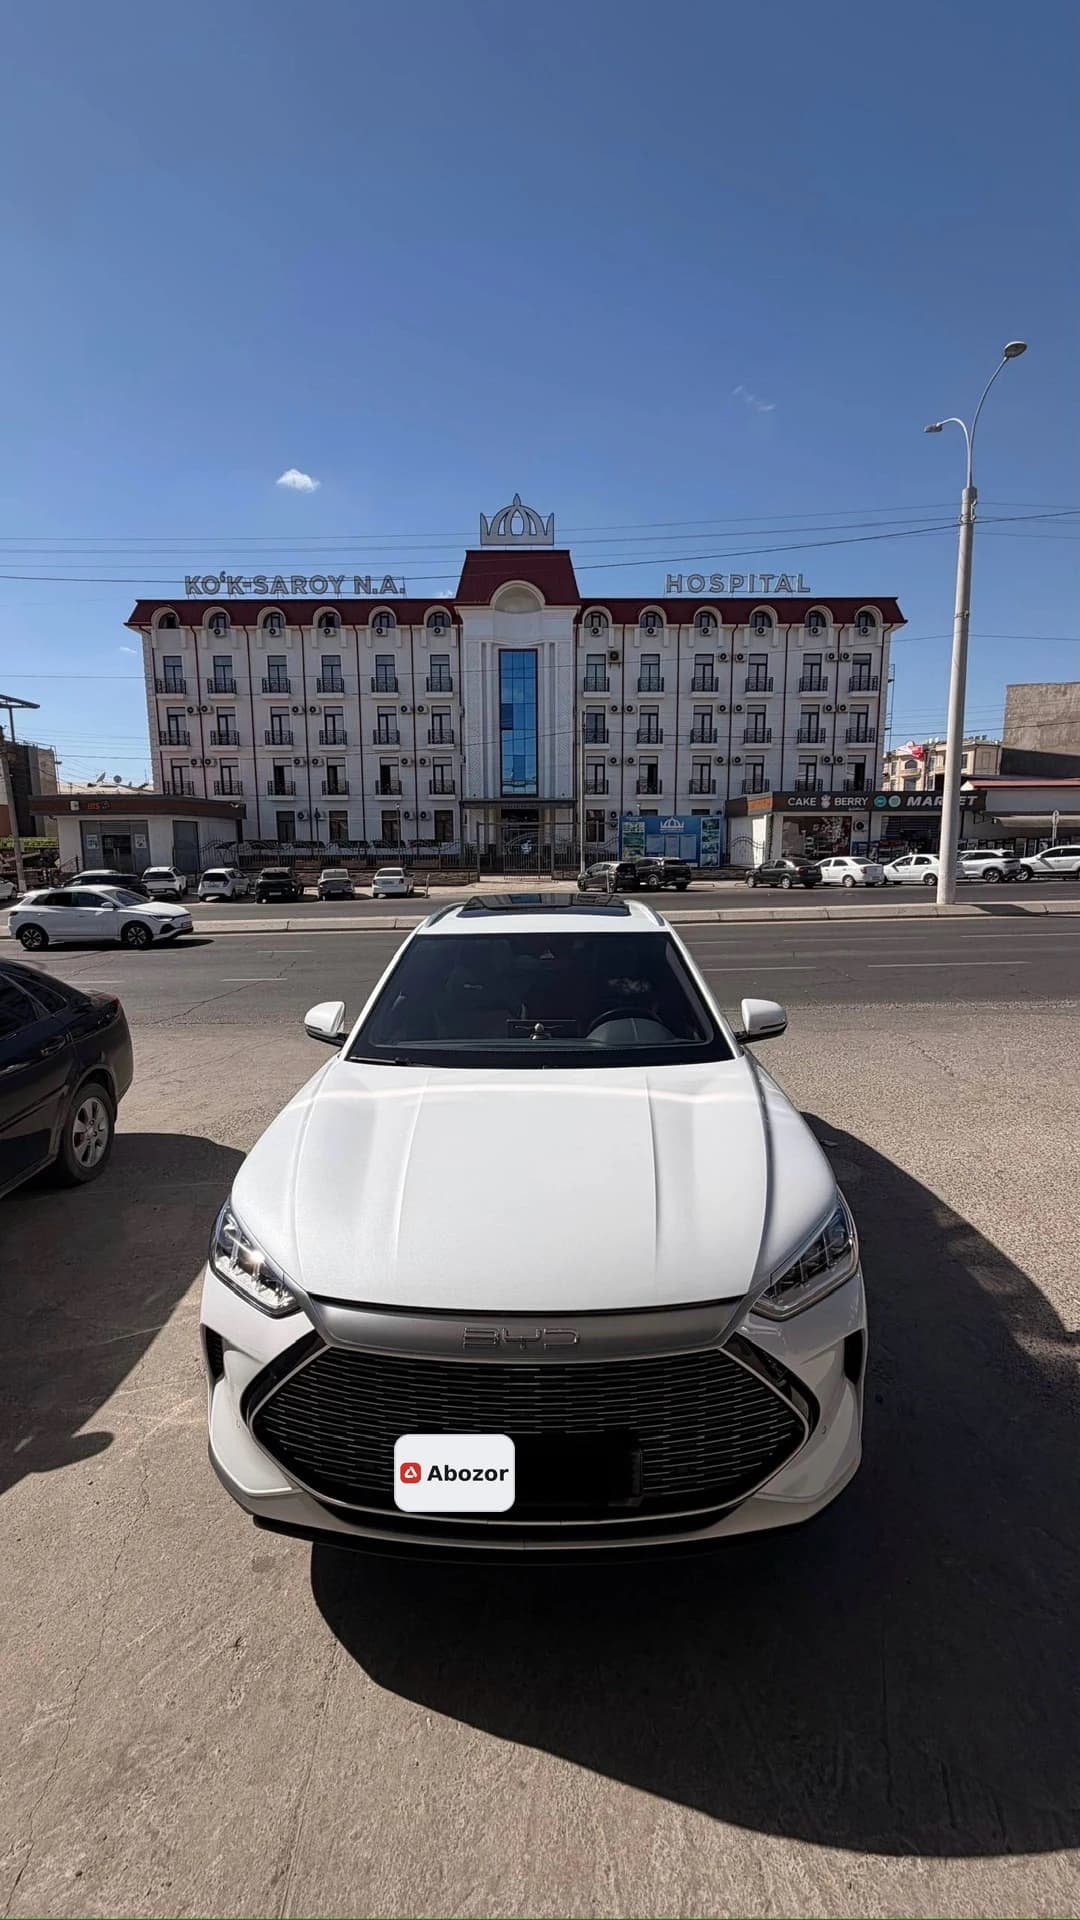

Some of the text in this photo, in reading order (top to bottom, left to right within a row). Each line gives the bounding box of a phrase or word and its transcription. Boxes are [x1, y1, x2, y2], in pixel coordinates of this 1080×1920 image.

[354, 575, 406, 595] N.A.
[665, 573, 811, 593] HOSPITAL
[787, 797, 869, 807] CAKE BERRY
[906, 796, 978, 807] MARET
[463, 1327, 580, 1350] BYD
